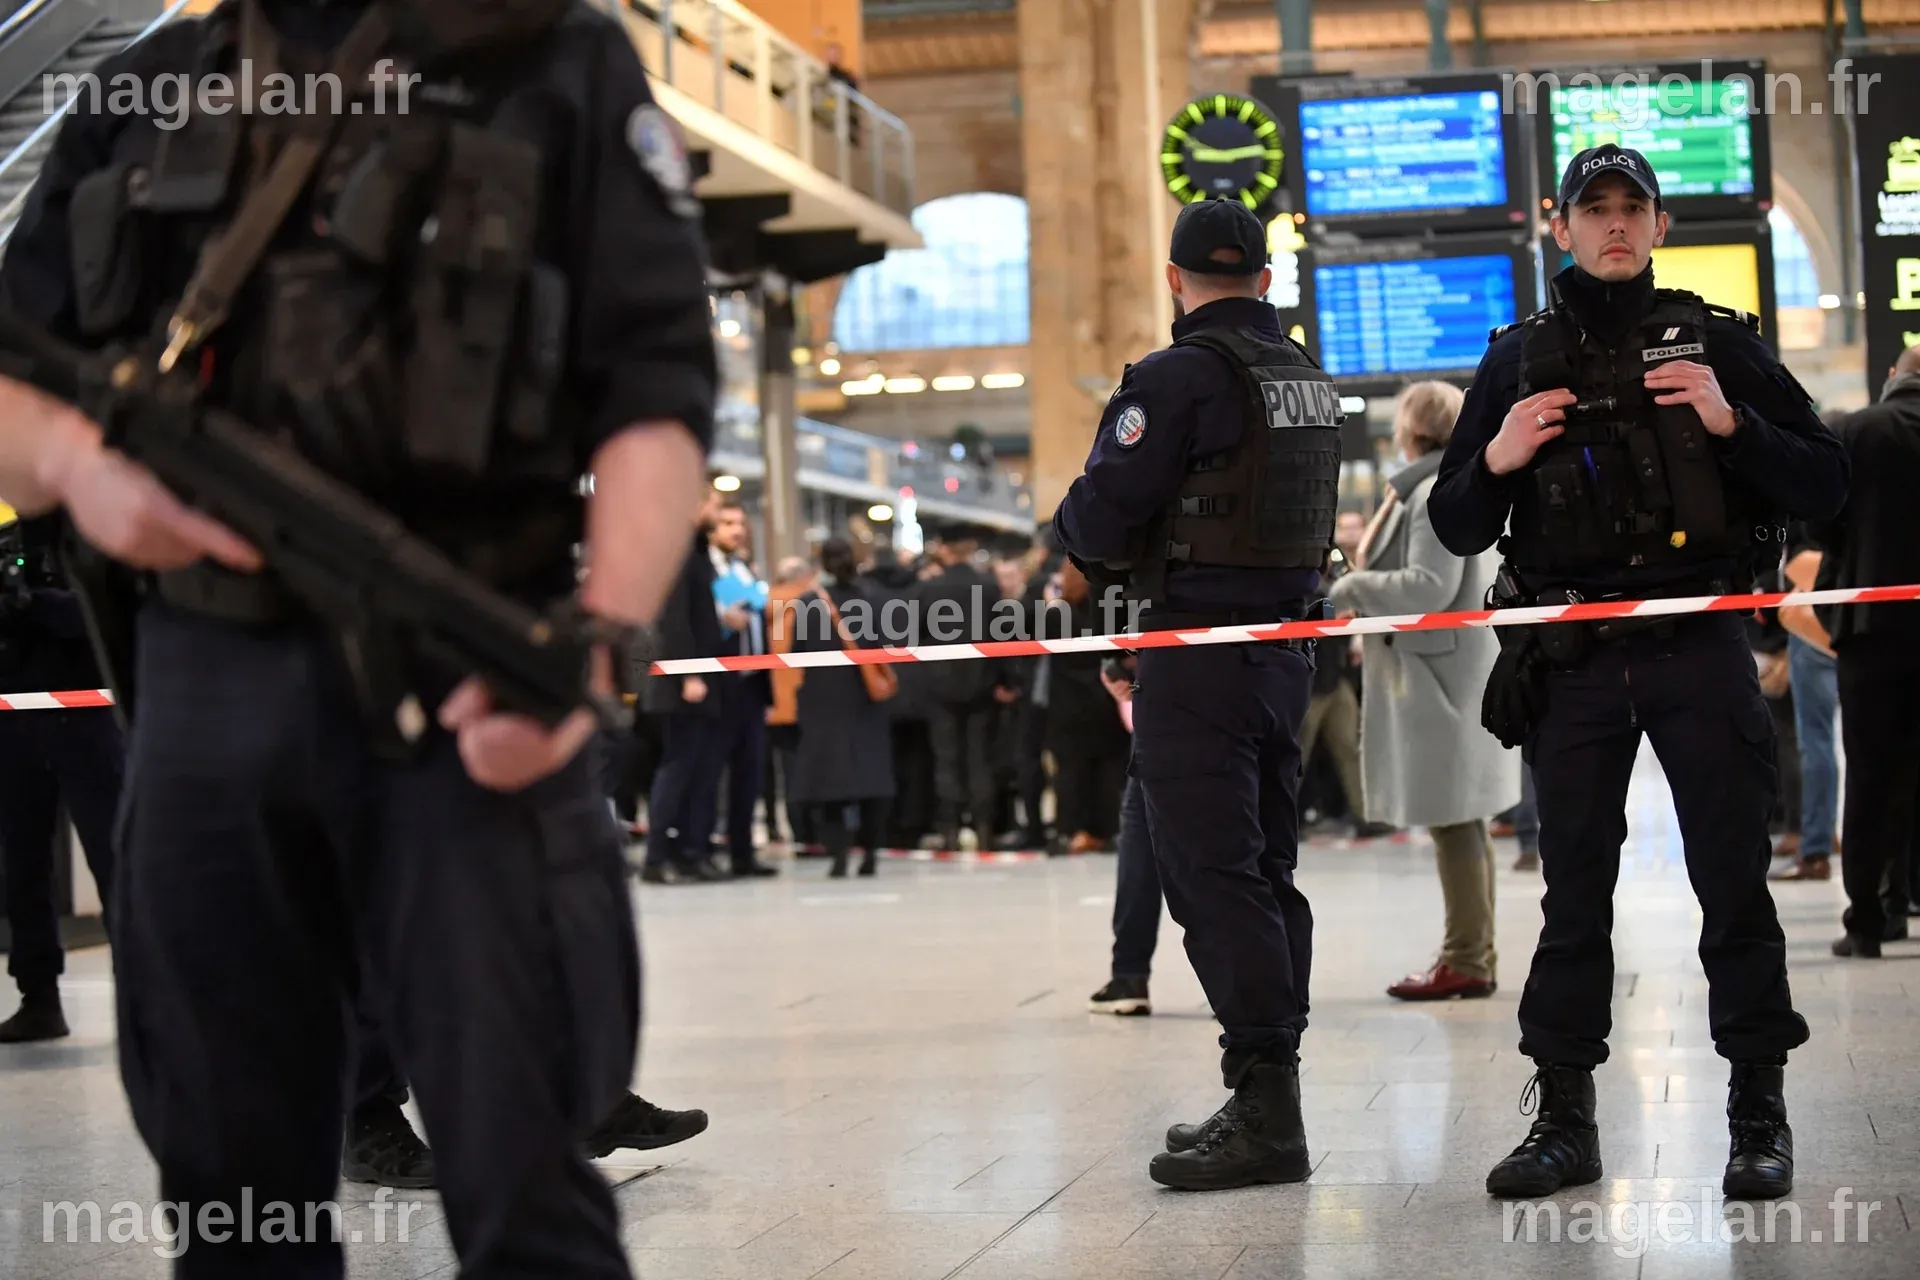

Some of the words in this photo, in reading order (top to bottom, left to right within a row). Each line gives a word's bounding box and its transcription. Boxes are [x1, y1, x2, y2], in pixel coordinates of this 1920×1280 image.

[1582, 154, 1637, 175] POLICE
[1647, 346, 1699, 359] POLICE
[1262, 382, 1345, 426] POLICE
